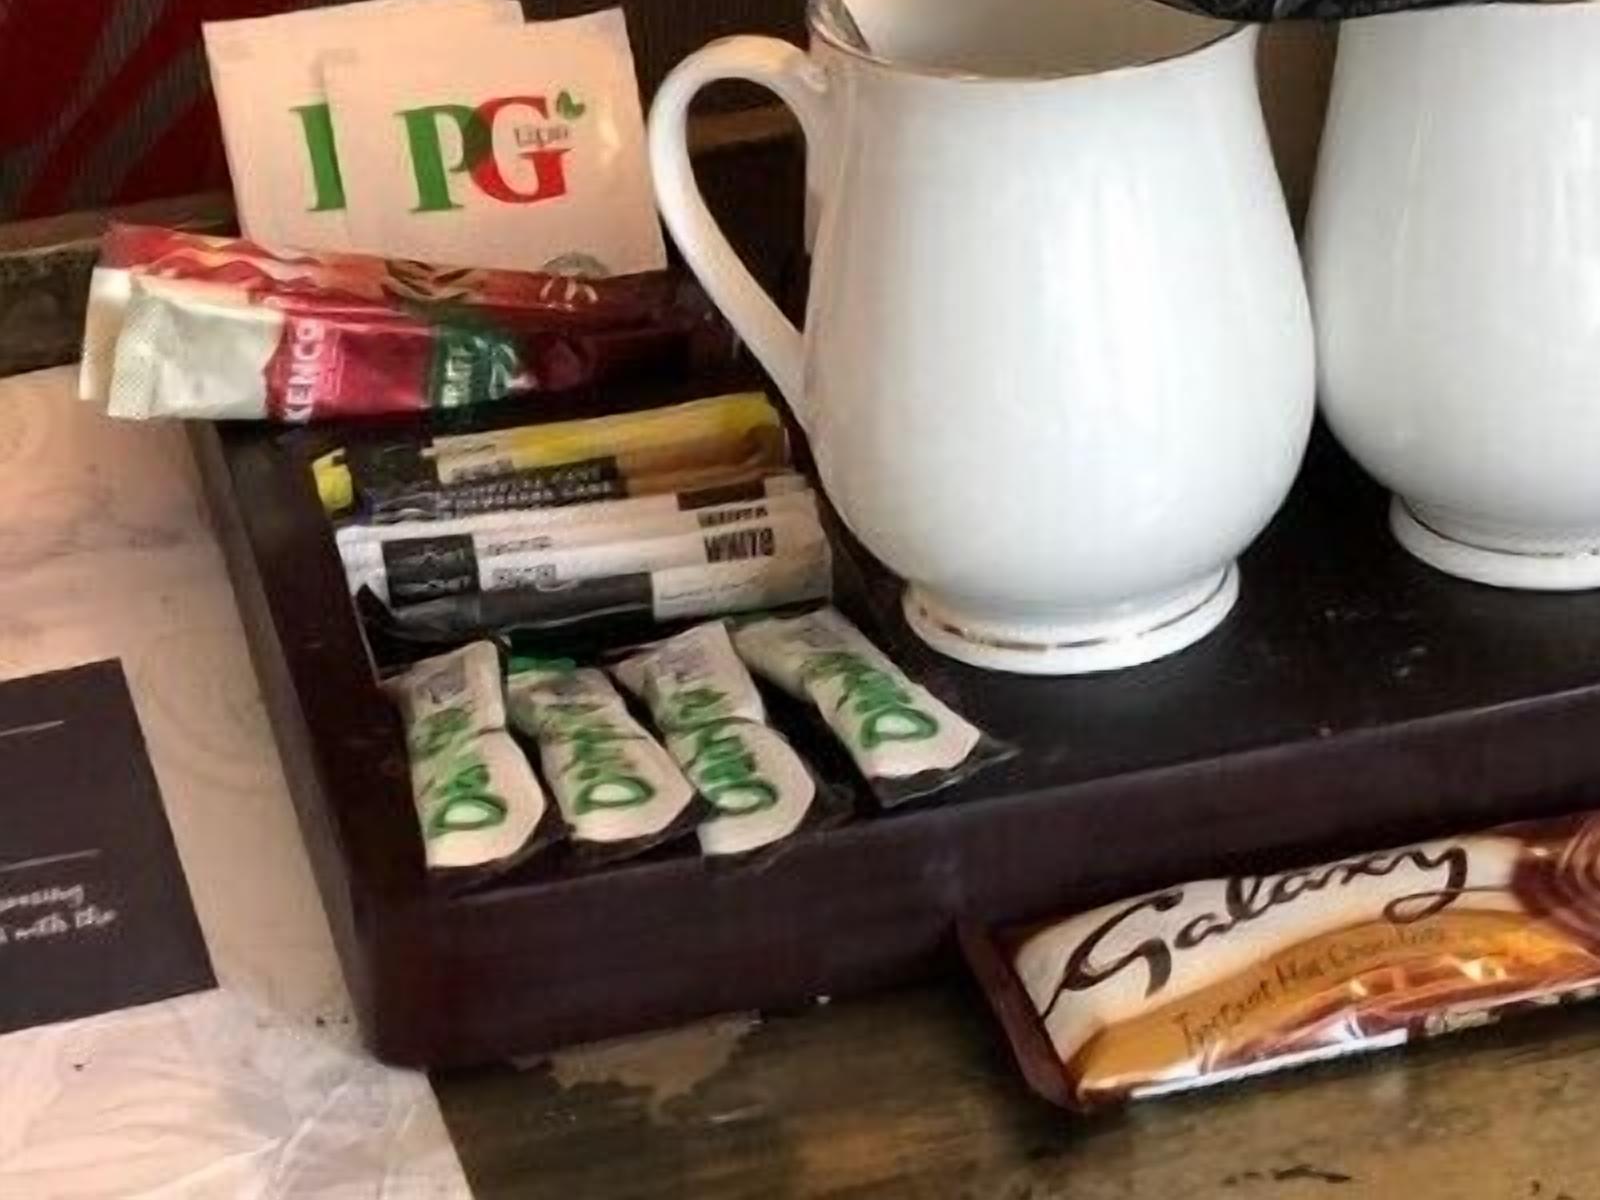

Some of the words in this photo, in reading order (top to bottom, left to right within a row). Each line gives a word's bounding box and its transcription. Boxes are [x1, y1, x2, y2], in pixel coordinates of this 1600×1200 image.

[394, 96, 576, 216] PG
[284, 315, 326, 423] KENCO
[1040, 845, 1480, 1018] Galaxy
